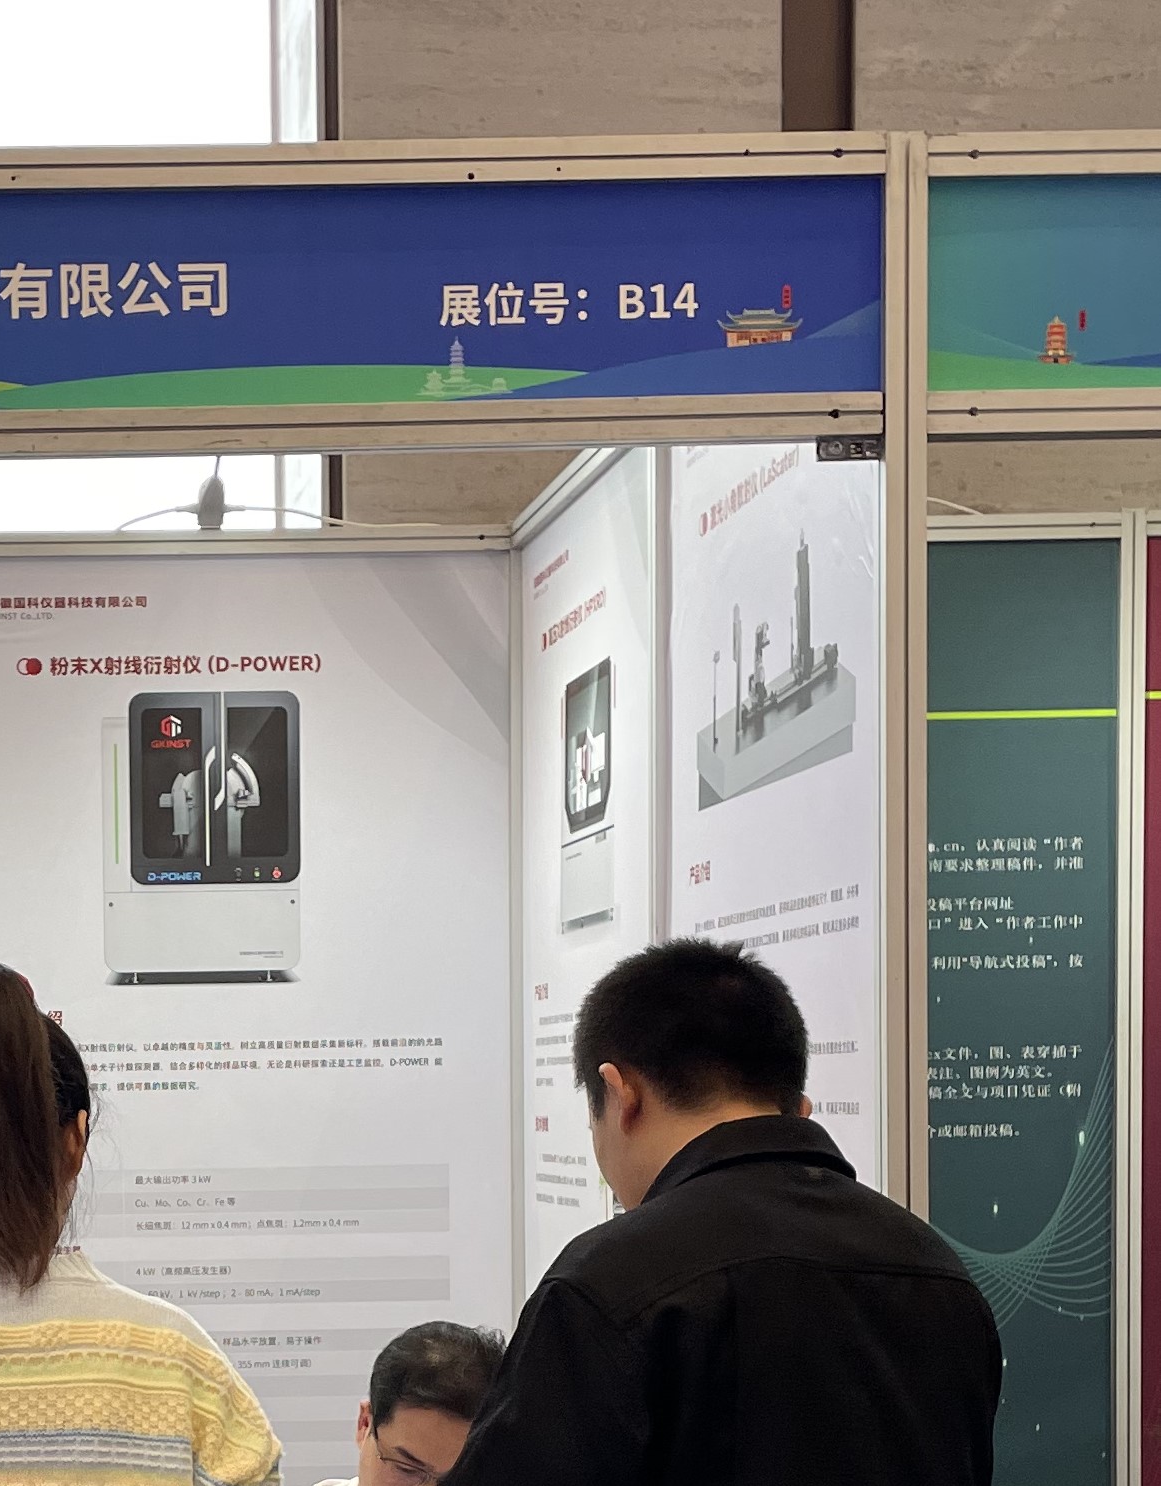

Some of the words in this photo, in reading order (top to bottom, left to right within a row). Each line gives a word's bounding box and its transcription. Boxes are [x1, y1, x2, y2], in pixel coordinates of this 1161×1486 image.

[439, 281, 589, 327] 展位号：
[618, 282, 699, 320] B14
[49, 655, 201, 676] 粉末X射线衍射仪
[207, 652, 321, 675] (D-POWER)
[148, 871, 202, 881] D-POWER
[134, 1174, 190, 1186] 最大输出功率
[197, 1174, 211, 1184] kW
